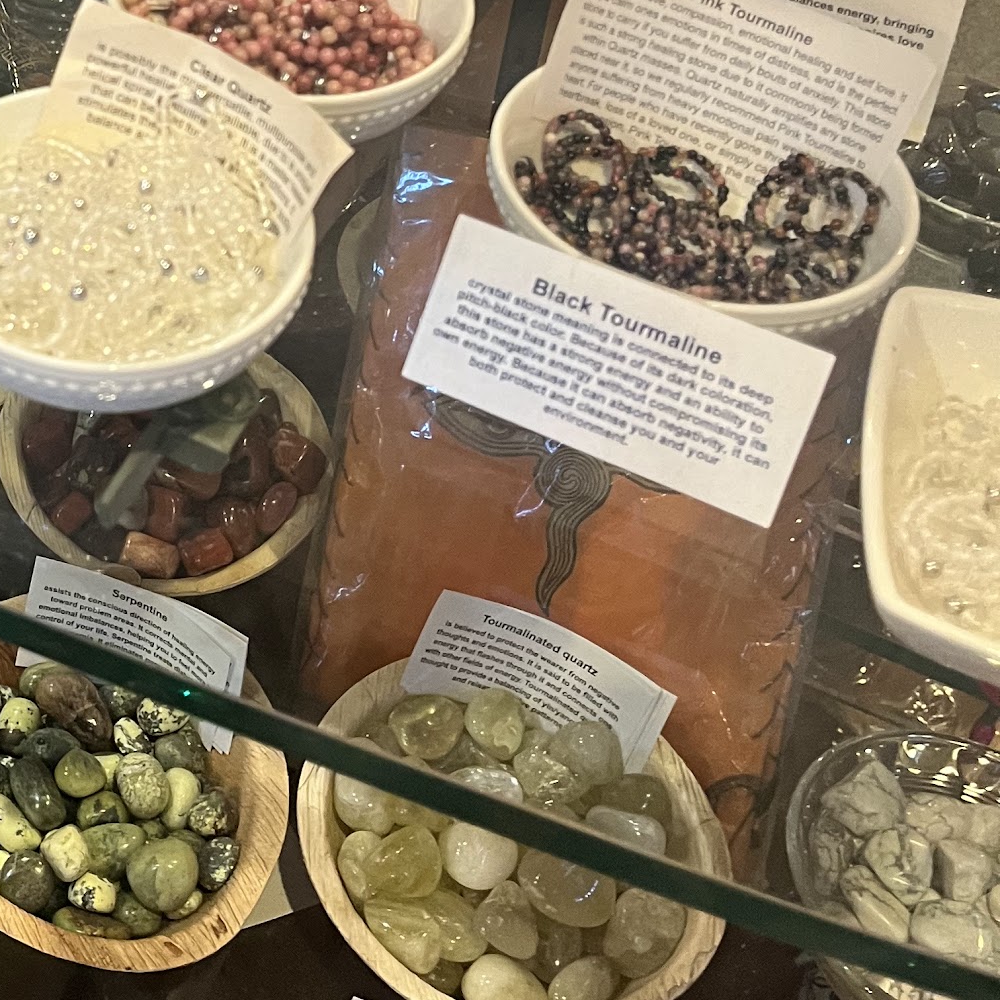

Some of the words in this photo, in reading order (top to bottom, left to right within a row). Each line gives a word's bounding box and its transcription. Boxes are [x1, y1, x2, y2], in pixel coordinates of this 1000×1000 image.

[730, 1, 814, 46] Tourmaline
[836, 6, 879, 24] energy,
[883, 16, 934, 38] bringing
[897, 35, 925, 51] love
[530, 277, 592, 316] Black
[598, 303, 723, 365] Tourmaline
[43, 585, 72, 597] assists
[73, 592, 86, 600] the
[87, 597, 128, 615] conscious
[129, 612, 162, 632] direction
[163, 629, 171, 637] of
[171, 634, 195, 657] healing
[112, 588, 168, 622] Serpentine
[453, 622, 487, 637] believed
[487, 632, 495, 640] to
[495, 636, 525, 651] protect
[525, 646, 539, 658] the
[540, 655, 567, 673] wearer
[568, 670, 587, 686] from
[483, 614, 561, 654] Tourmalinated
[562, 651, 599, 677] quartz
